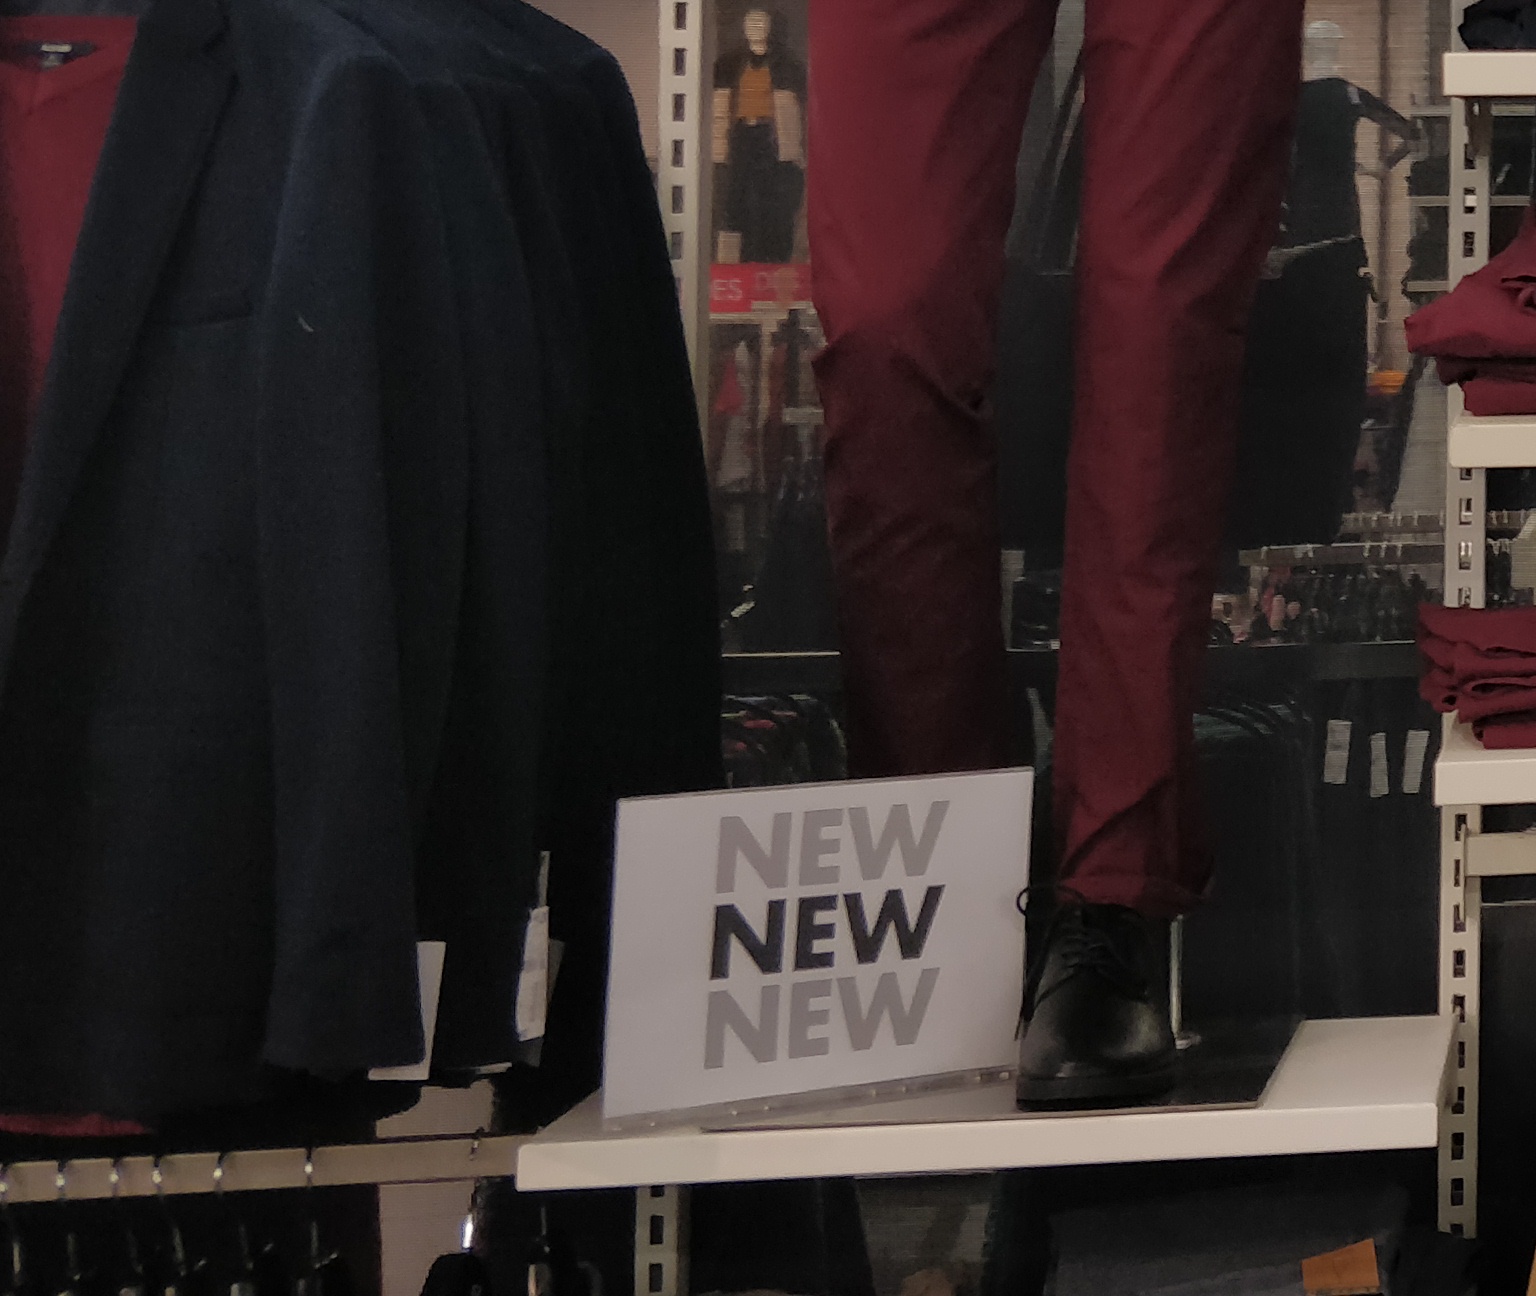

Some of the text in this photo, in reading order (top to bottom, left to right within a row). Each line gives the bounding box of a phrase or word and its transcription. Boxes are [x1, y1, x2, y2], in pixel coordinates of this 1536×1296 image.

[715, 800, 950, 895] NEW
[708, 884, 947, 982] NEW
[703, 967, 941, 1070] NEW
